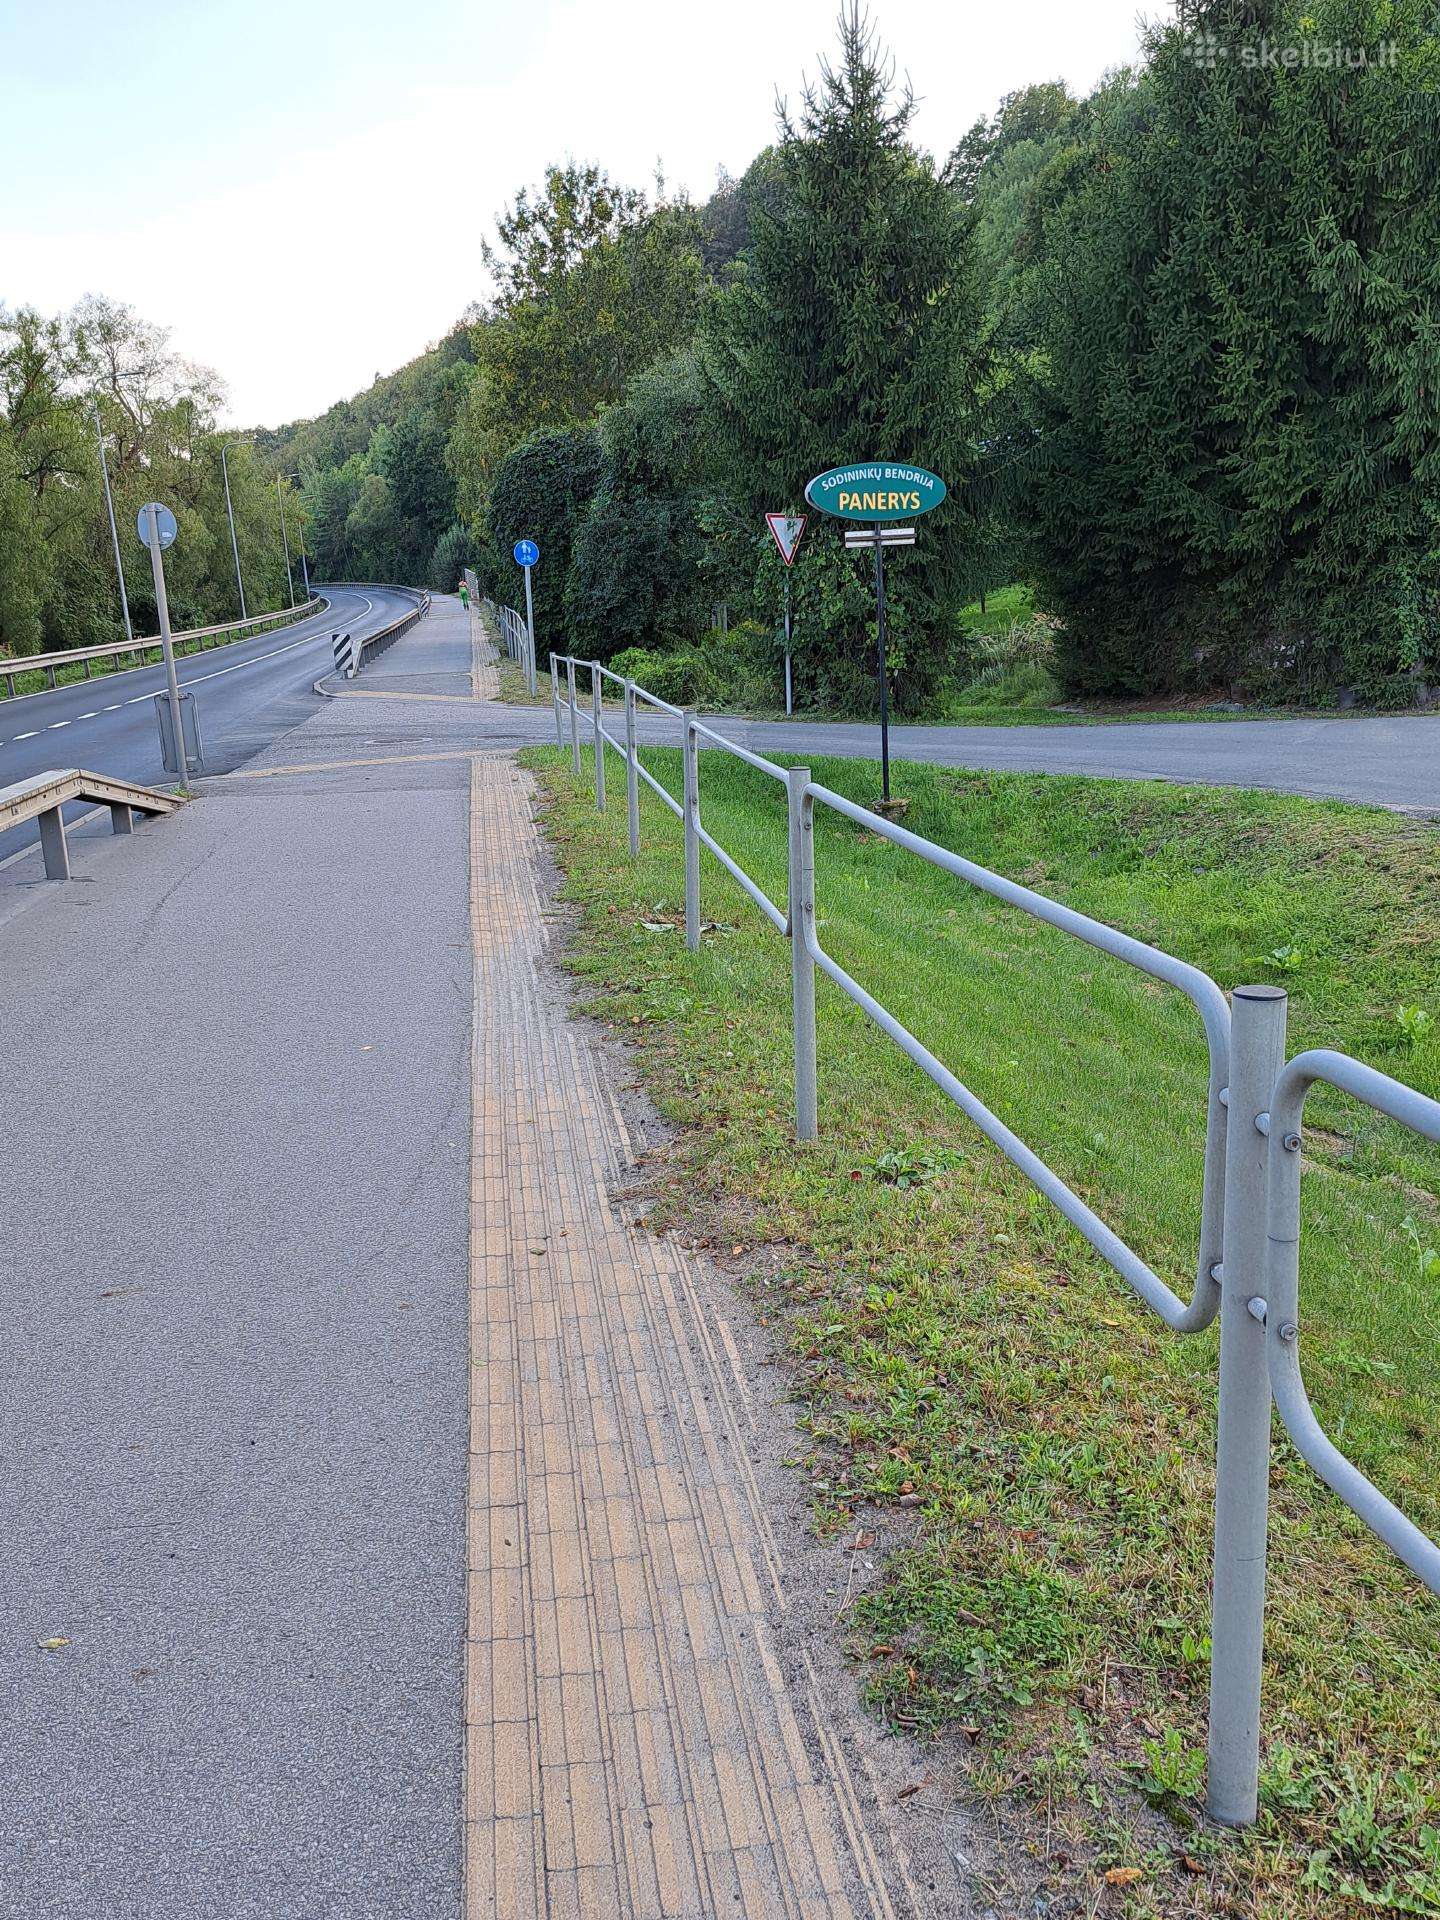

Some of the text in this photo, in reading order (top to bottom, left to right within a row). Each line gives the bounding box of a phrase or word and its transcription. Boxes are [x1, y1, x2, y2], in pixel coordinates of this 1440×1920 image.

[821, 468, 934, 491] SODININKŲ BENDRIJA
[838, 492, 921, 511] PANERYS
